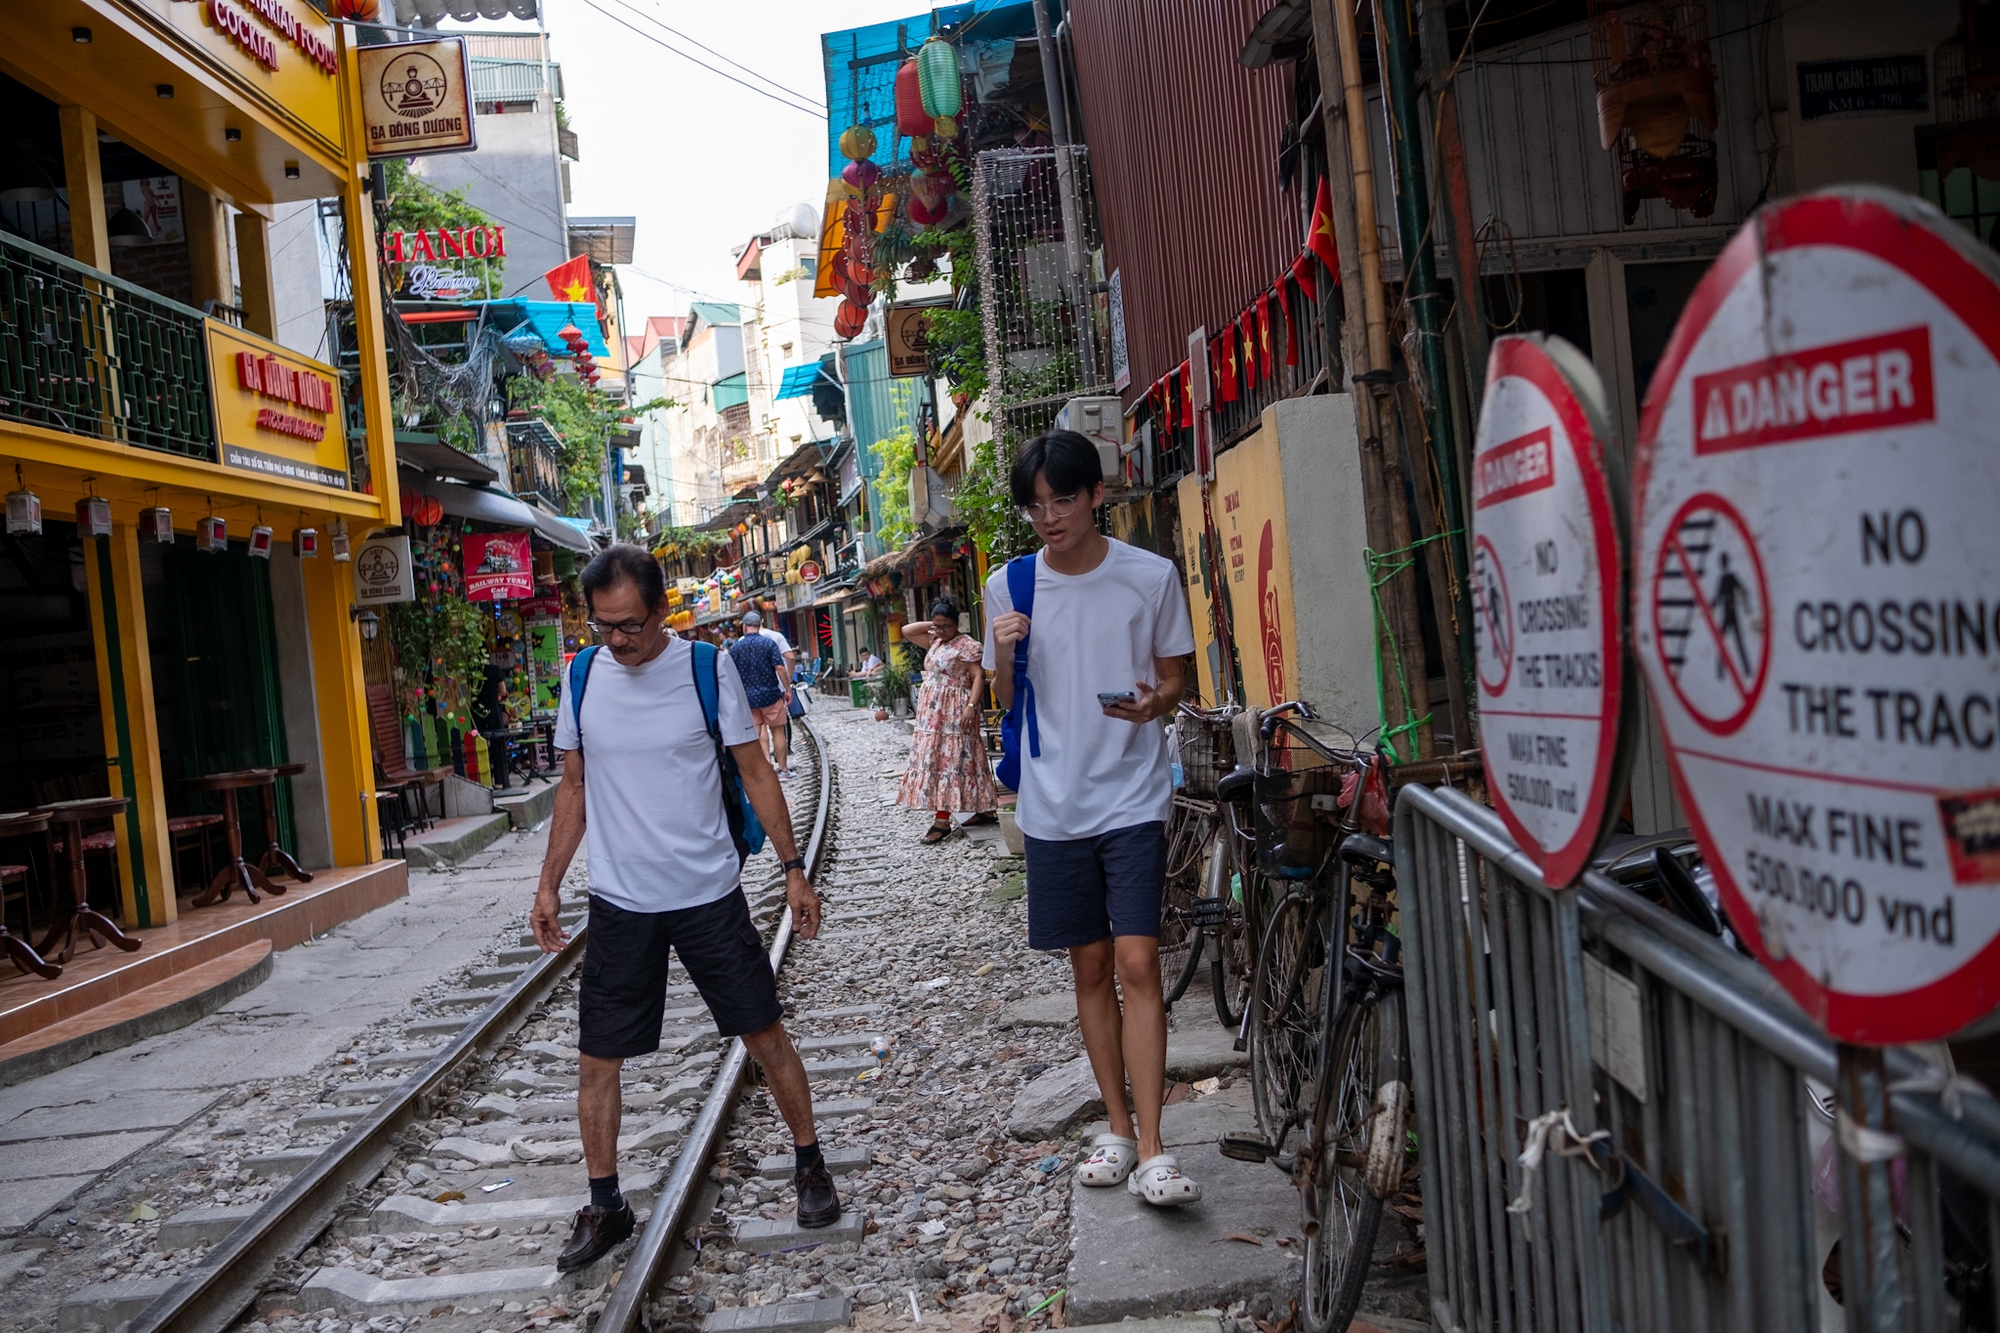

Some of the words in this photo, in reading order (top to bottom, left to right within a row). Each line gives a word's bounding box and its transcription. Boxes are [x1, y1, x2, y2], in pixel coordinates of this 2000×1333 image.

[301, 26, 338, 74] FOODS
[1804, 72, 1834, 96] TRẠM
[1828, 97, 1854, 111] KM
[1857, 96, 1864, 108] 0
[1880, 92, 1902, 106] 790
[371, 126, 386, 140] GA
[389, 121, 420, 138] ĐÔNG
[423, 117, 462, 134] DƯƠNG
[378, 225, 507, 264] HANOI
[241, 351, 263, 393] GA
[1731, 349, 1916, 435] DANGER
[1486, 440, 1549, 491] DANGER
[1860, 507, 1927, 565] NO
[1535, 540, 1559, 577] NO
[469, 578, 504, 590] RAILWAY
[506, 577, 527, 587] TUAN
[1516, 596, 1590, 634] CROSSING
[1516, 654, 1544, 689] THE
[1544, 652, 1601, 689] TRACKS
[1781, 681, 1857, 739] THE
[1864, 687, 2000, 751] TRAC
[1507, 731, 1536, 765] MAX
[1537, 735, 1569, 768] FINE
[1554, 786, 1578, 816] vnd
[1746, 793, 1817, 852] MAX
[1825, 807, 1926, 870] FINE
[1876, 894, 1956, 948] vnd
